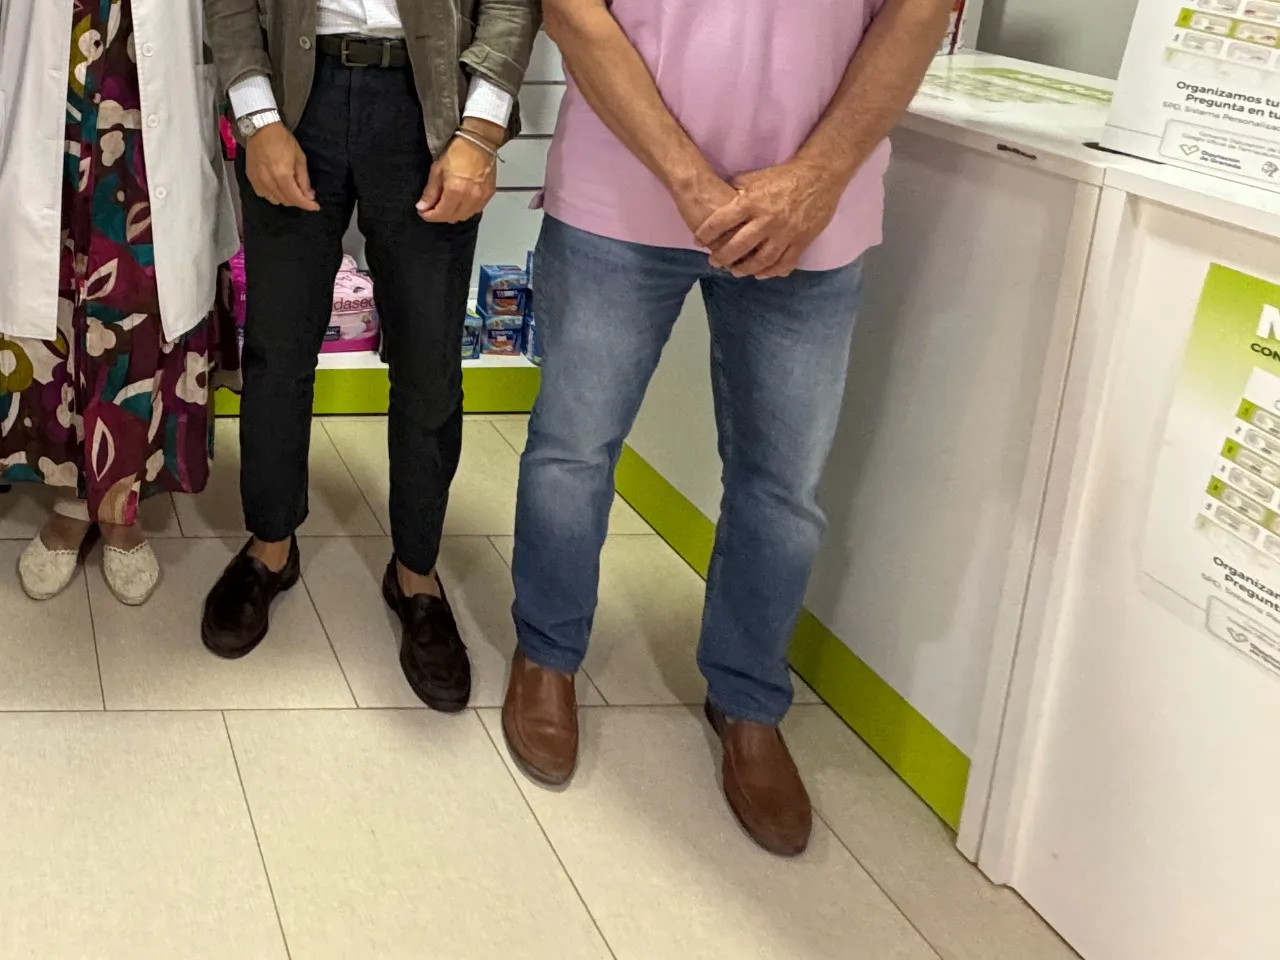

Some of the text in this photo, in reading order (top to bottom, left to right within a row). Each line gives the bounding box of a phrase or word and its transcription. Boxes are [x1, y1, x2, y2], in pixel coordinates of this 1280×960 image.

[1176, 81, 1280, 108] Organizamos tu
[1185, 93, 1245, 113] Pregunta
[1248, 107, 1265, 117] en
